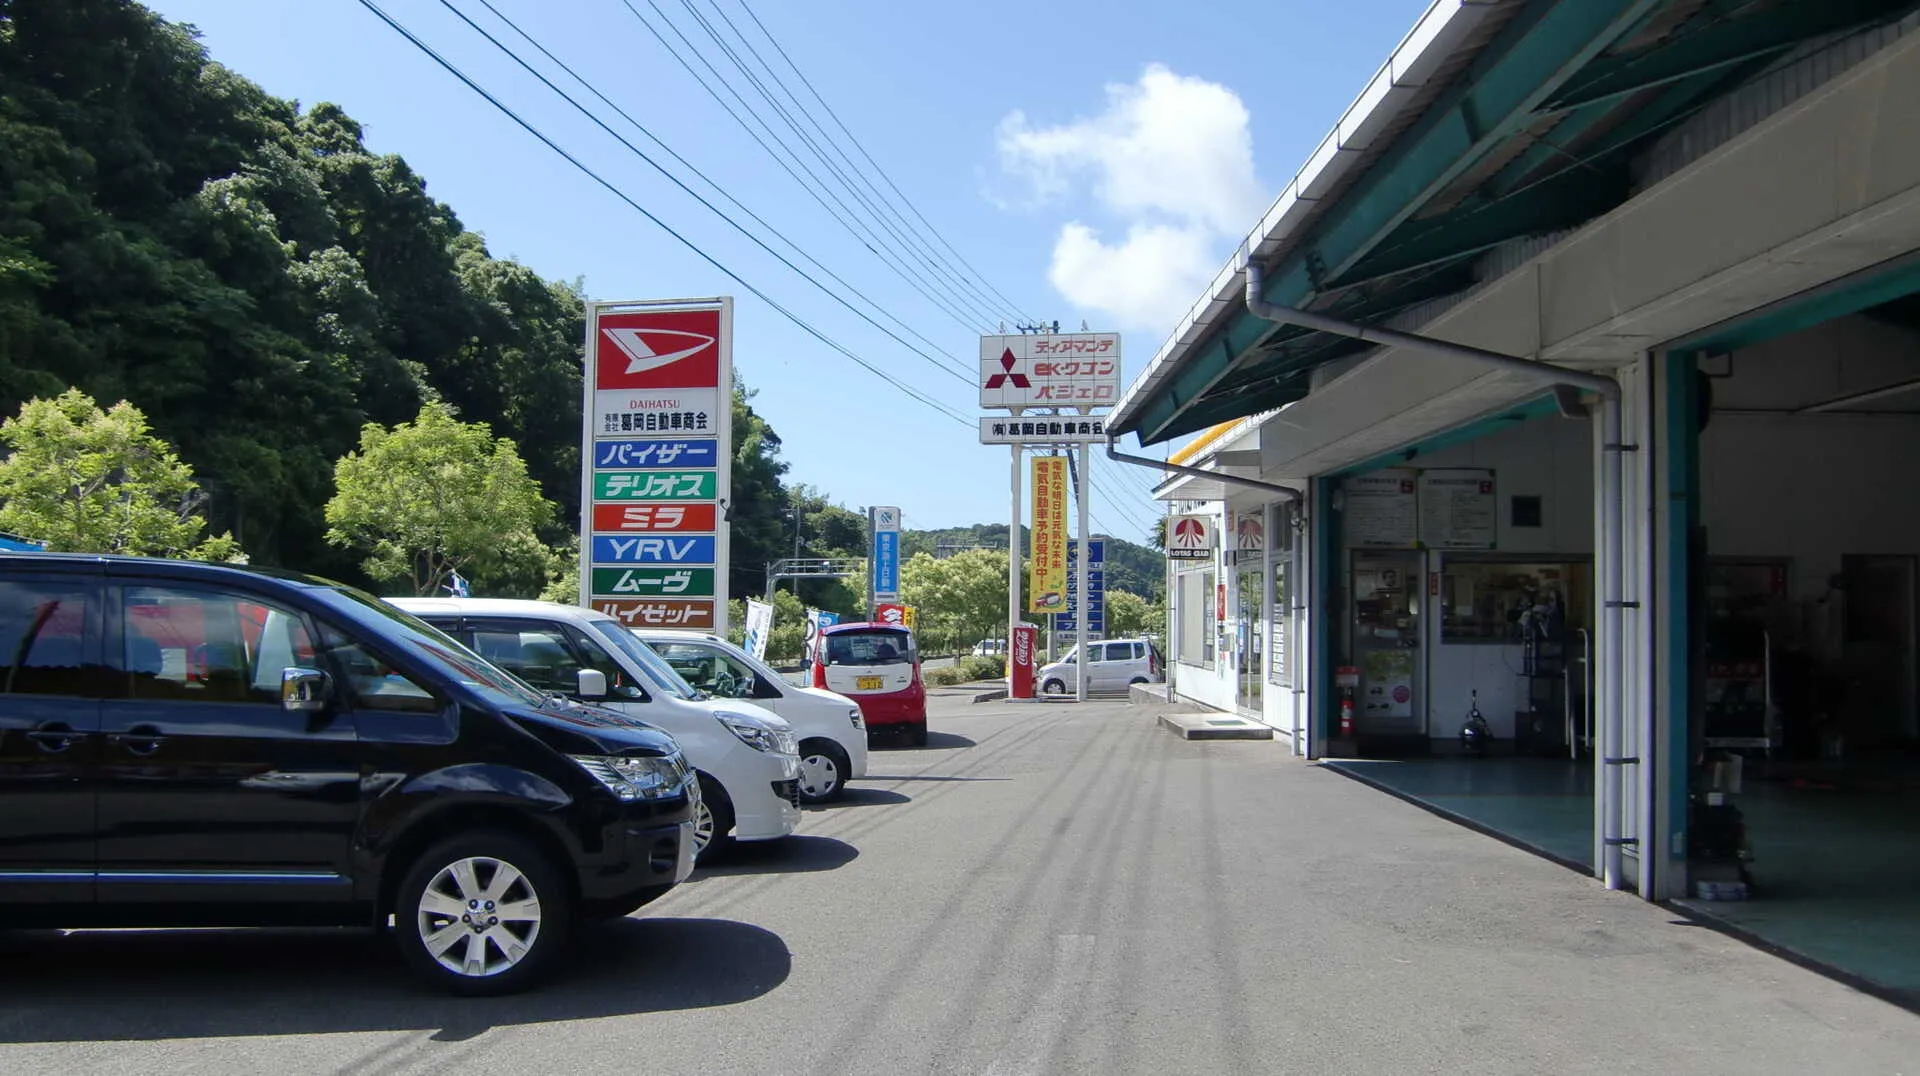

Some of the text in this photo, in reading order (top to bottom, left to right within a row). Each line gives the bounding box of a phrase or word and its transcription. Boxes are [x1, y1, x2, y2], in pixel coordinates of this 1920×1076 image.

[630, 400, 680, 409] DAIHATSU
[601, 444, 708, 464] パイザー
[605, 475, 704, 496] テリオス
[621, 507, 685, 528] ミラ
[609, 539, 696, 560] YRV
[612, 570, 692, 592] ムーヴ
[603, 604, 707, 623] ハイゼット
